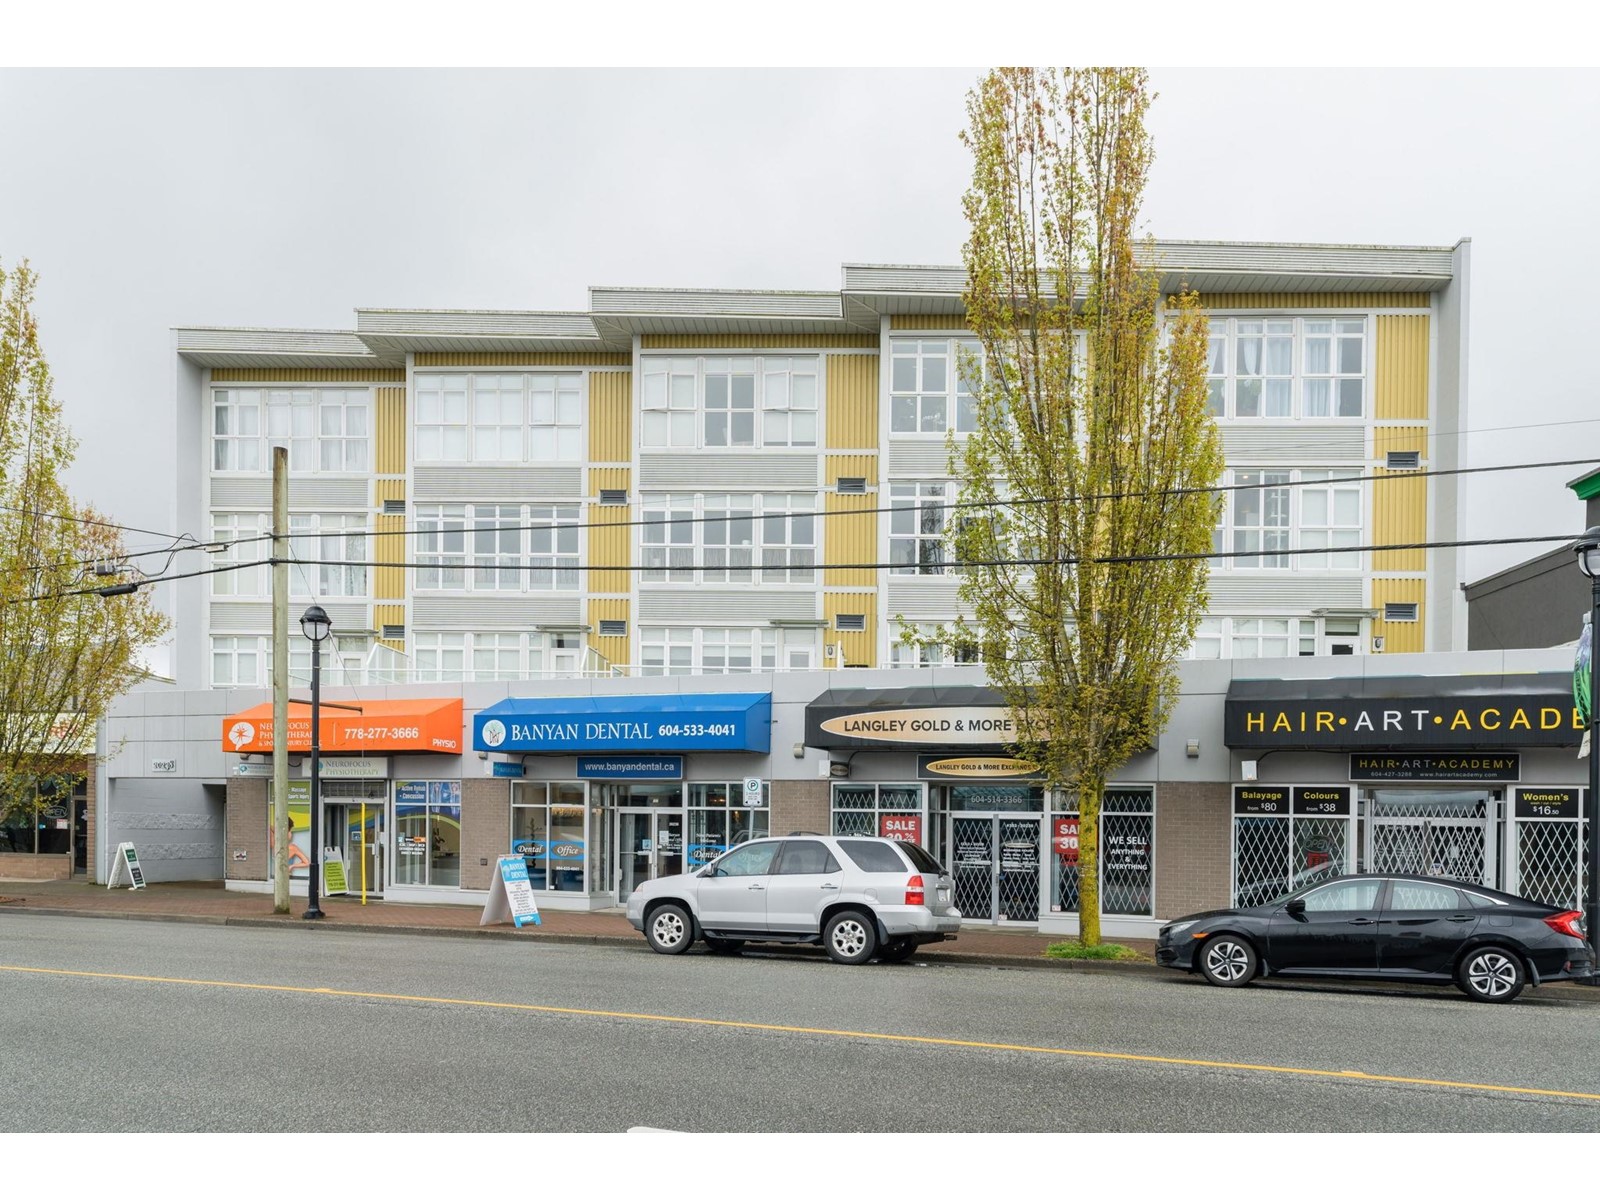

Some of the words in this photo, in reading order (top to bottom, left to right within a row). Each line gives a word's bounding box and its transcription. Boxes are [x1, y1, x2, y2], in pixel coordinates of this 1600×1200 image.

[1451, 708, 1585, 732] ACADE
[844, 719, 907, 732] LANGLEY
[911, 719, 951, 732] GOLD
[954, 719, 964, 732] &
[968, 719, 1012, 732] MORE
[344, 727, 419, 739] 778-277-3666
[511, 723, 579, 741] BANYAN
[585, 722, 653, 740] DENTAL
[658, 724, 736, 737] 604-533-4041
[432, 738, 457, 749] PHYSIO
[325, 760, 372, 768] NEUROFOCUS
[584, 762, 675, 773] www.banyandental.ca
[1438, 759, 1515, 768] ACADEMY
[325, 768, 379, 776] PHYSIOTHERAPY
[970, 795, 1023, 804] 604-514-3366
[1241, 791, 1282, 800] Balayage
[1303, 791, 1340, 800] Colours
[1522, 793, 1569, 801] Women's
[1261, 802, 1277, 812] $80
[1319, 803, 1336, 812] $38
[1533, 805, 1560, 815] $16.50
[886, 820, 916, 831] SALE
[1060, 824, 1080, 835] SA
[1108, 836, 1124, 845] WE
[1126, 836, 1147, 845] SELL
[518, 844, 544, 853] Dental
[557, 845, 579, 856] Office
[693, 849, 722, 859] Dental
